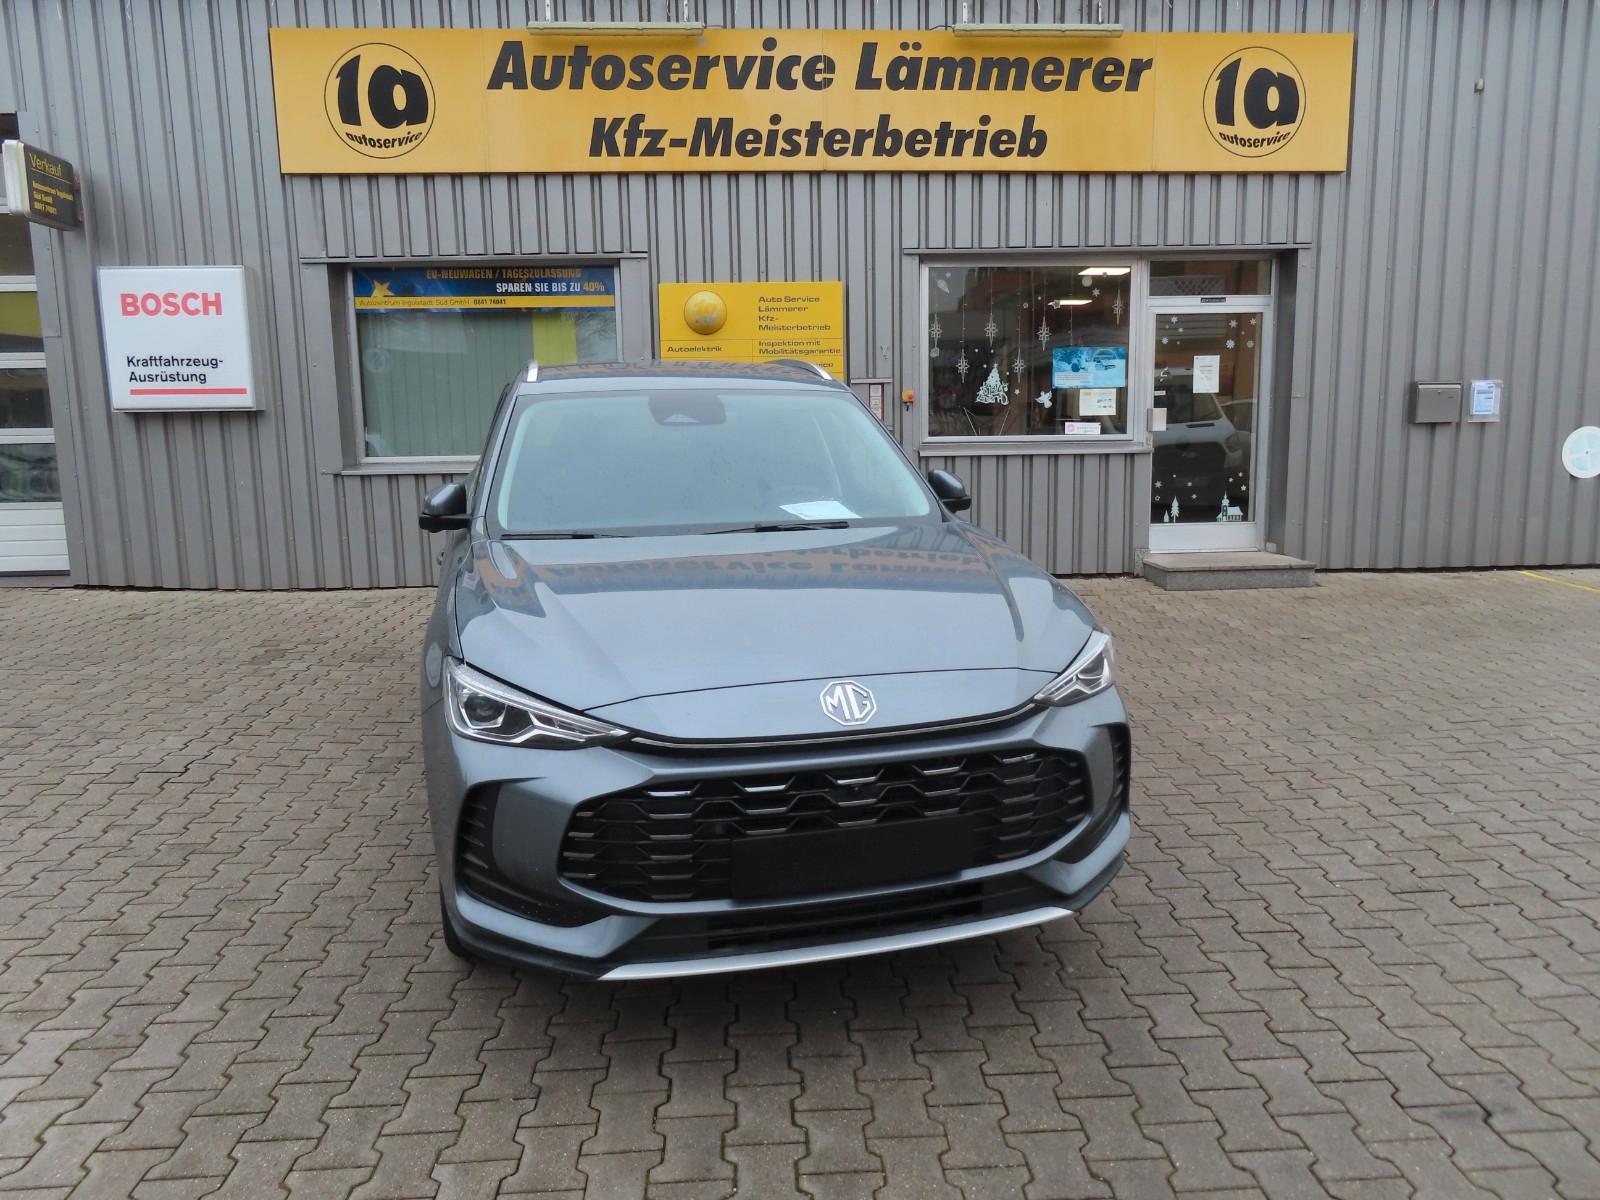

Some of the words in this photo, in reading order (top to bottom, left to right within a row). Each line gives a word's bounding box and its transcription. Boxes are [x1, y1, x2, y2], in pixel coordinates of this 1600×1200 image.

[486, 37, 836, 91] Autoservice
[855, 42, 1153, 93] Lämmerer
[335, 53, 429, 129] 1a
[1215, 56, 1300, 129] 1a
[345, 131, 423, 149] autoservice
[588, 114, 1048, 158] Kfz-Meisterbetrieb
[1218, 130, 1291, 148] autoservice
[29, 152, 62, 177] Verkauf
[426, 268, 493, 280] EU-NEUWAGEN
[502, 268, 582, 279] TAGESZULASSUNG
[496, 282, 532, 293] SPAREN
[534, 282, 550, 292] SIE
[551, 282, 567, 292] BIS
[569, 282, 581, 292] ZU
[583, 281, 605, 292] 40%
[120, 292, 223, 317] BOSCH
[758, 305, 808, 313] Lämmerer
[126, 355, 224, 369] Kraftfahrzeug-
[128, 369, 207, 384] Ausrüstung
[825, 684, 871, 720] MG
